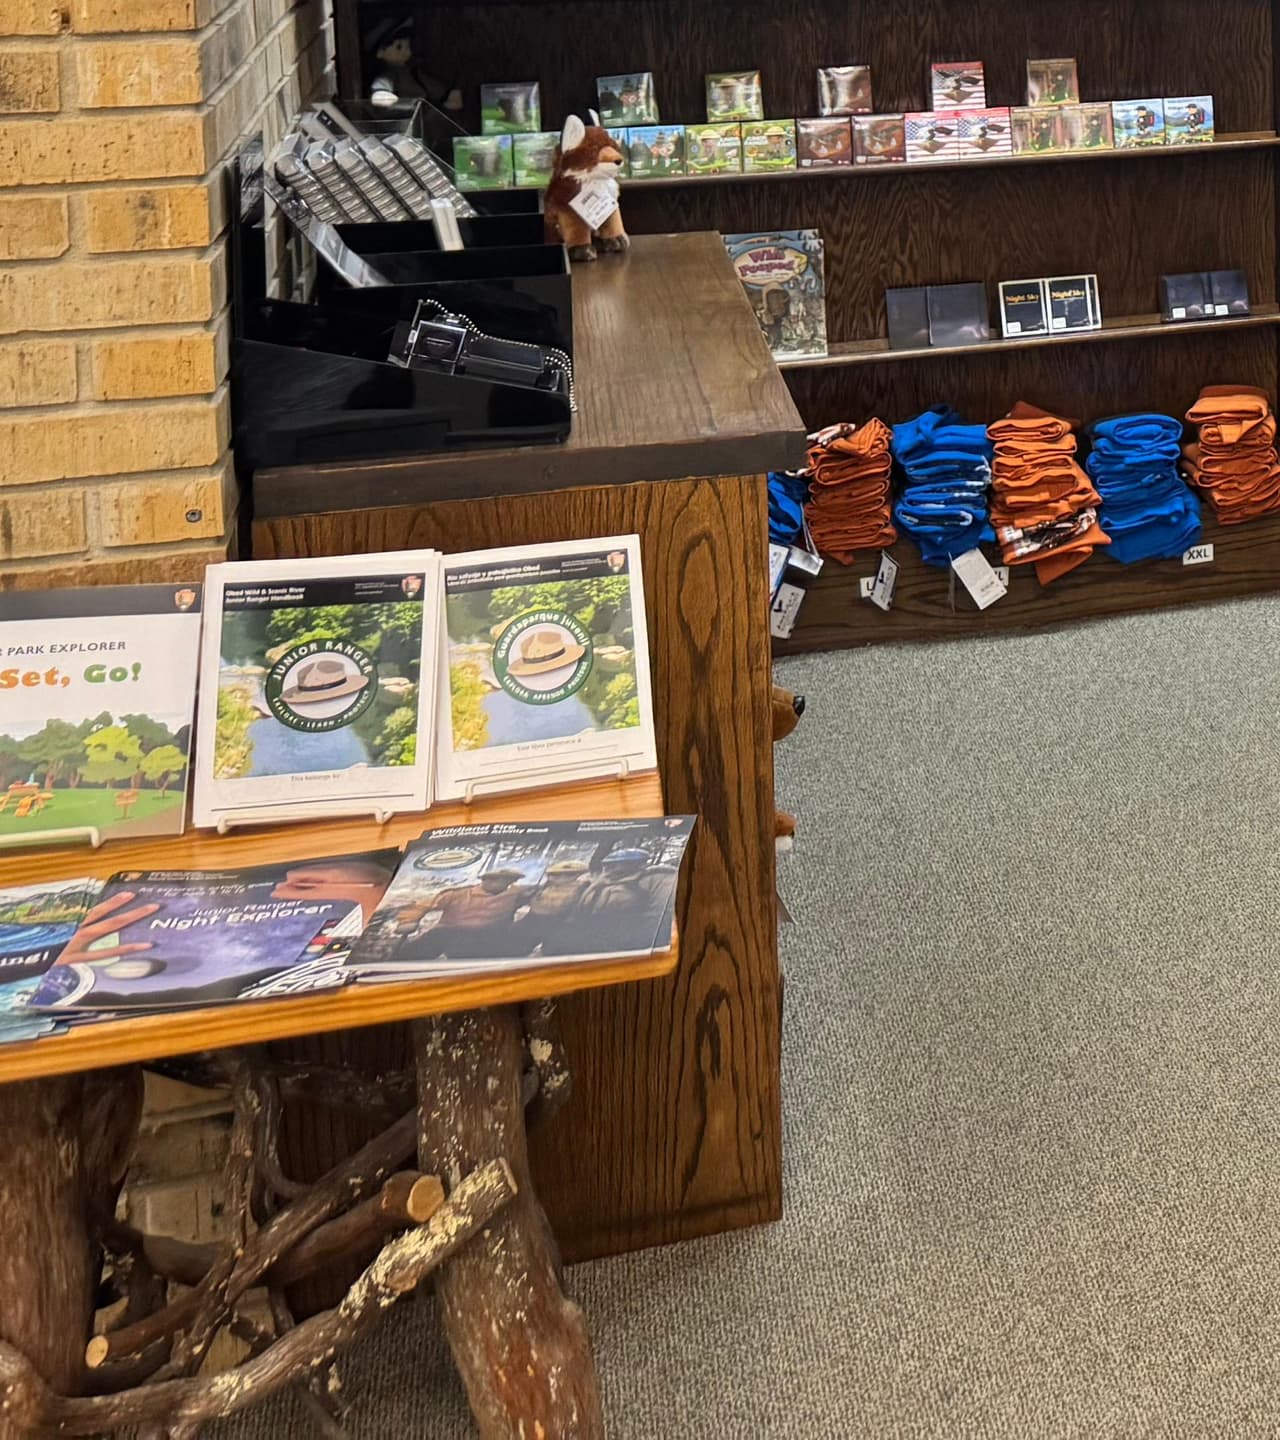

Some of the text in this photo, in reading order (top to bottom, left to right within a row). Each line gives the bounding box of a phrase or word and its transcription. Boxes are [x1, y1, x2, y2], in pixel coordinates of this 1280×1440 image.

[1051, 290, 1068, 300] Night
[1186, 548, 1211, 561] XXL
[247, 594, 304, 603] Ranger Handbook
[497, 613, 559, 658] Guardaparque
[8, 642, 126, 656] PARK EXPLORER
[272, 640, 372, 680] JUNIOR RANGER
[0, 662, 141, 689] Set, Go!
[272, 690, 370, 728] EXPLORE LEARN PROTECT
[431, 824, 491, 836] Wildland
[150, 903, 334, 930] Night Explorer
[189, 899, 303, 918] Junior Ranger
